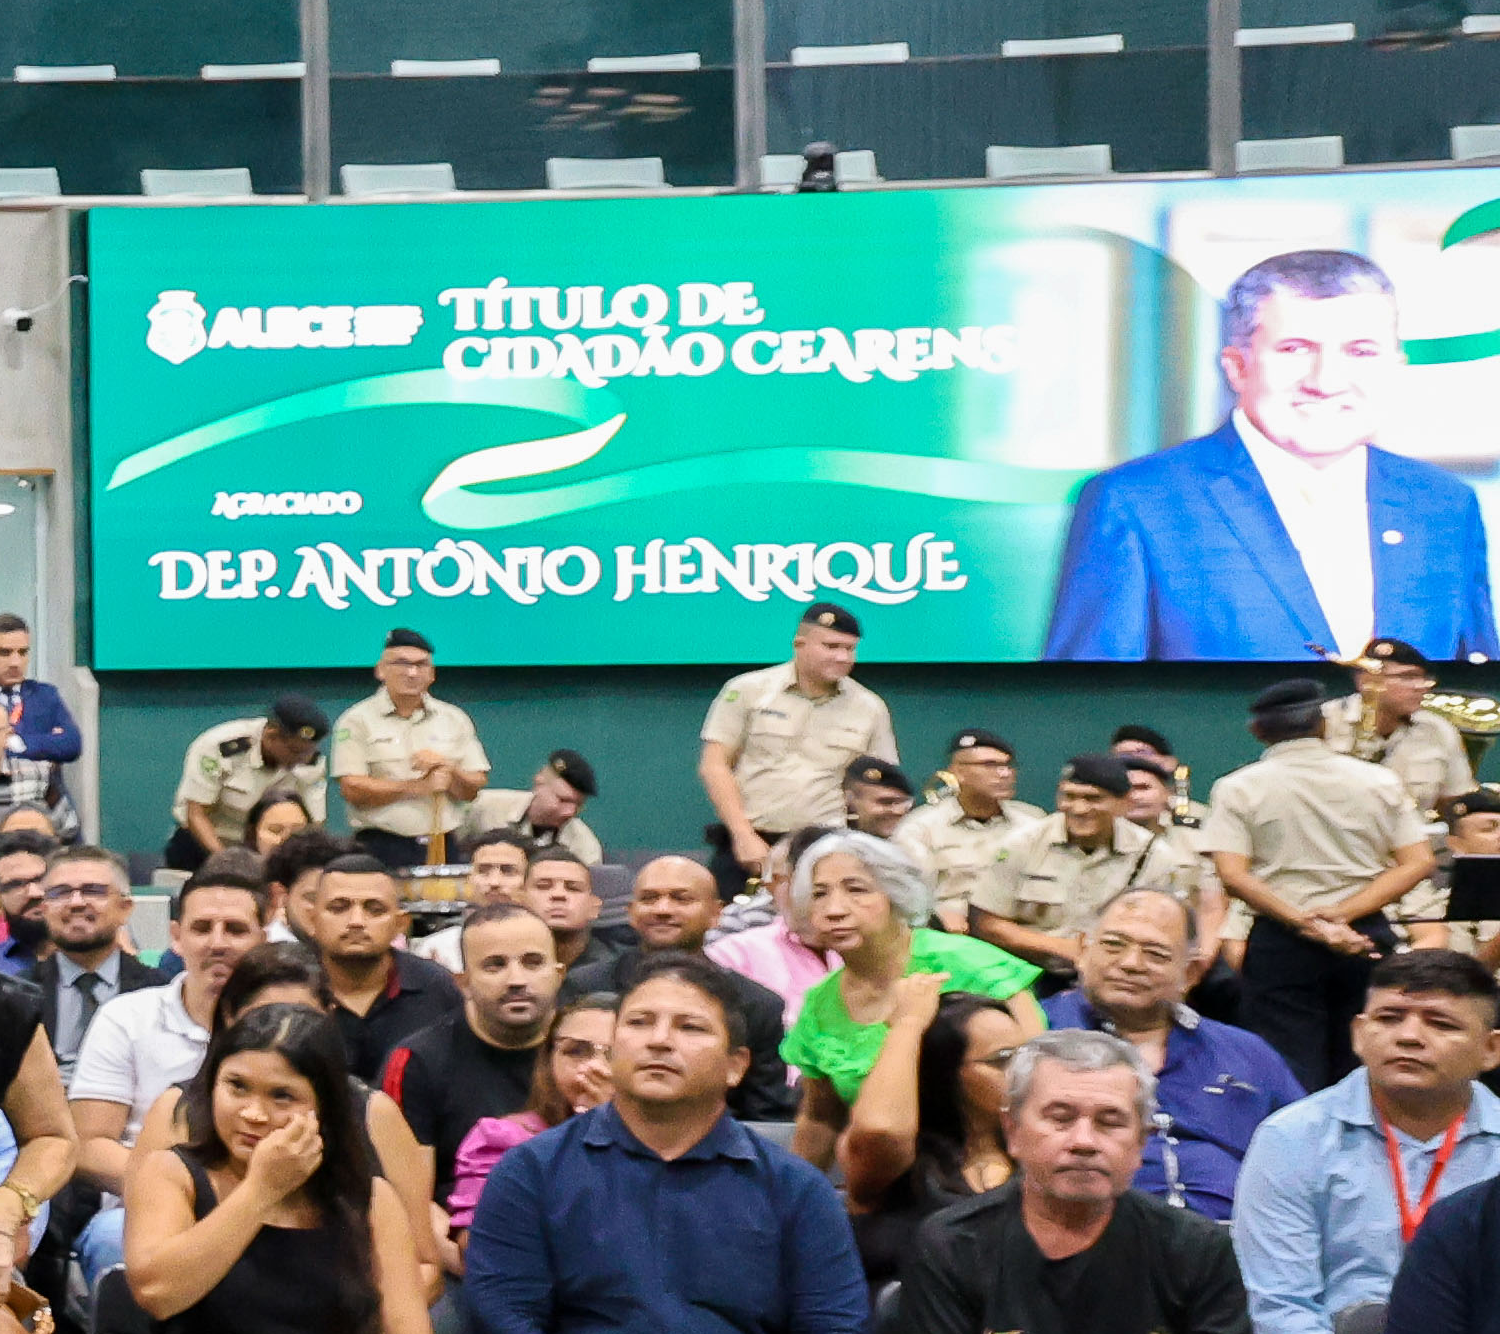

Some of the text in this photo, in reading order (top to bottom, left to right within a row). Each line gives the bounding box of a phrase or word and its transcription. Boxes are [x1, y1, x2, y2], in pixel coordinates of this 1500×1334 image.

[437, 277, 670, 331] TÍTULO
[676, 281, 765, 326] DE
[442, 323, 725, 389] CIDADÃO
[147, 531, 969, 609] DEP. ANTÔNIO HENRIQUE
